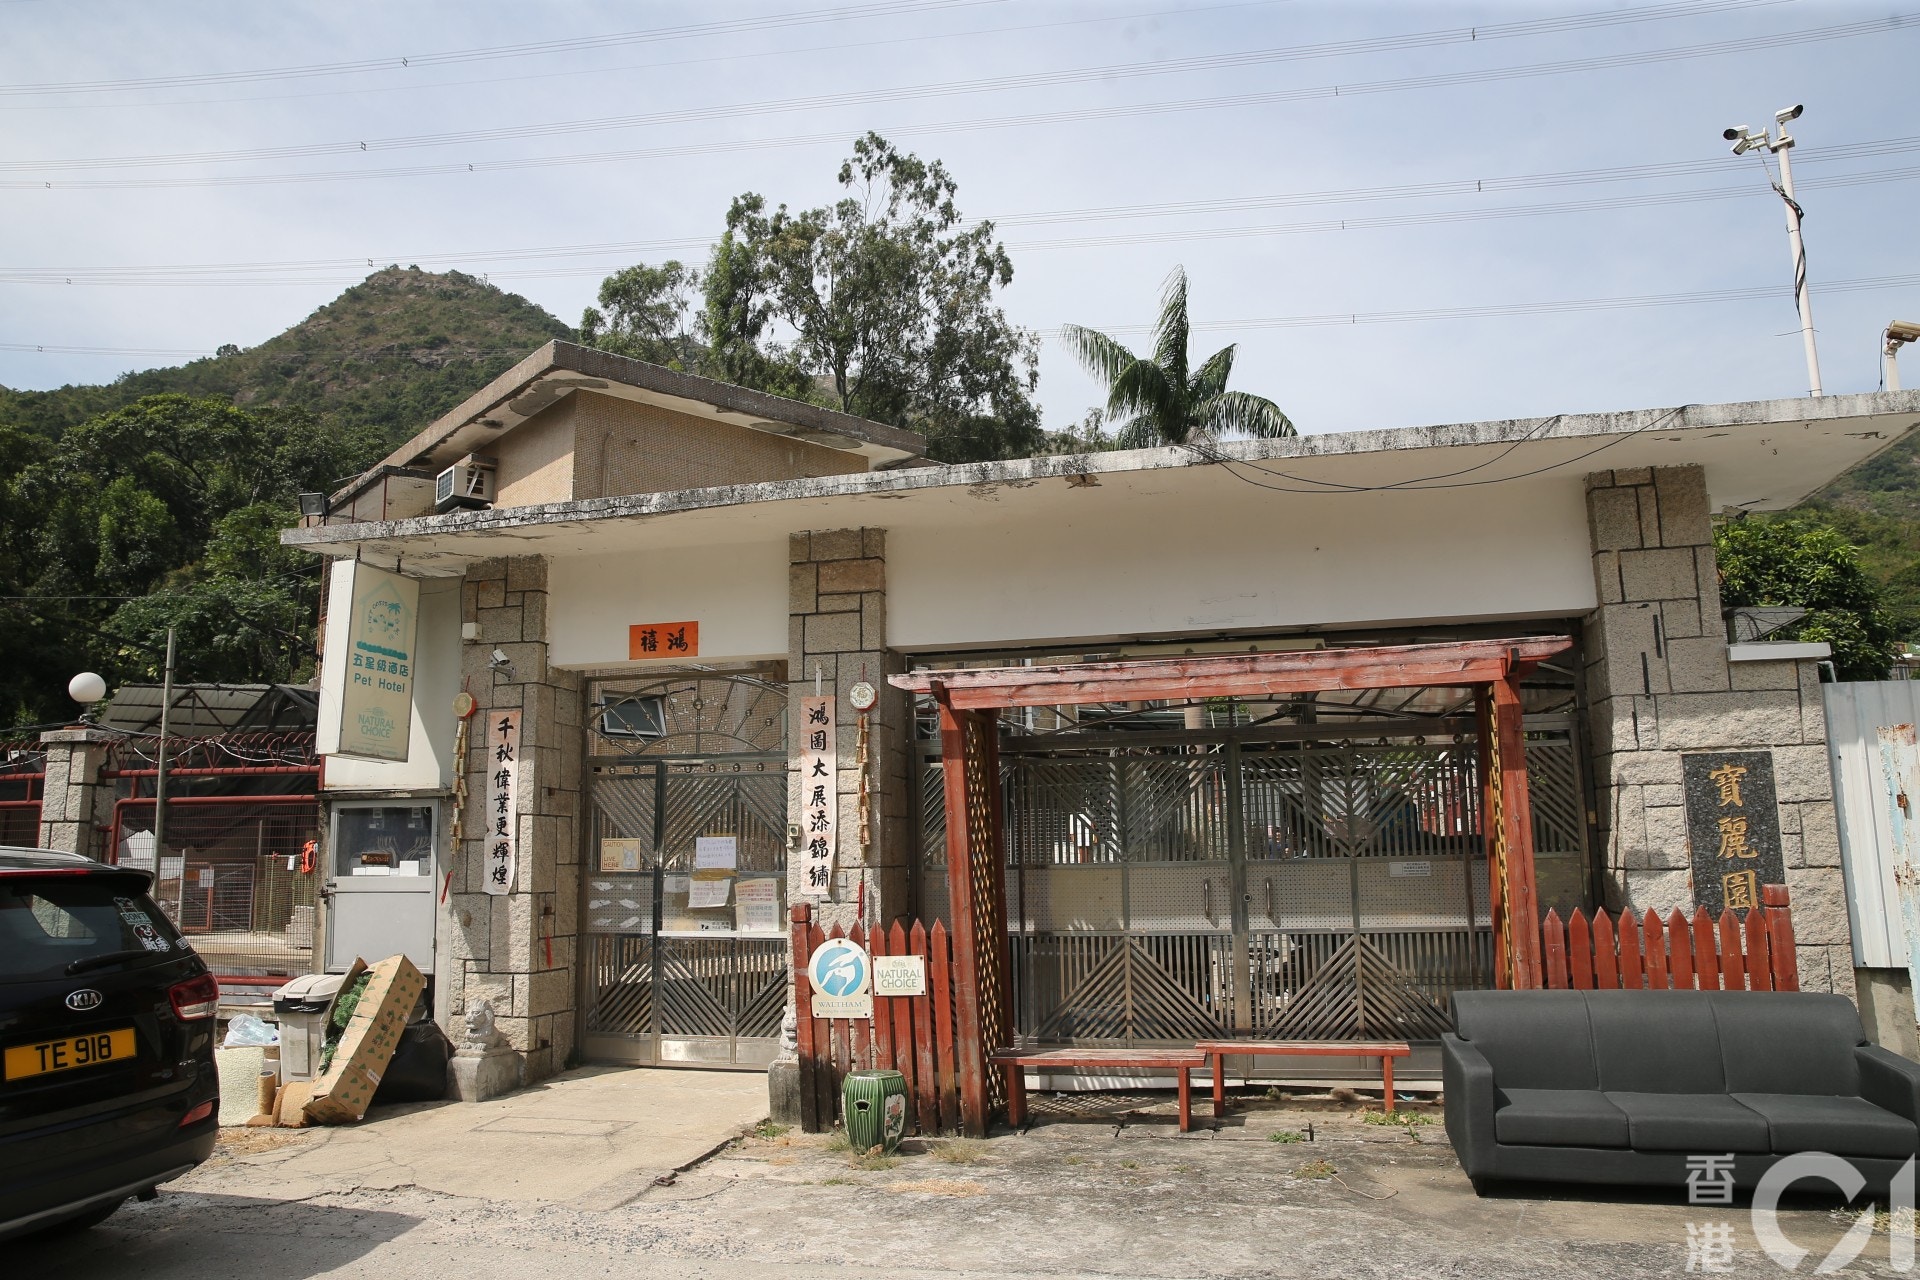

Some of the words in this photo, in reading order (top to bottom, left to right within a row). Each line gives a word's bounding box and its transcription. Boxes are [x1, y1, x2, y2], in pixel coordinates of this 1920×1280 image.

[353, 653, 409, 677] 五星級酒店
[354, 673, 372, 686] Pet
[378, 678, 405, 693] Hotel
[358, 714, 395, 729] NATURAL
[361, 725, 391, 738] CHOICE
[491, 716, 514, 885] 千秋偉業更輝煌
[808, 702, 830, 888] 鴻圖大展添錦繡
[1709, 762, 1759, 910] 寶麗園
[877, 969, 922, 979] NATURAL
[881, 979, 917, 988] CHOICE
[73, 992, 98, 1007] KIA
[35, 1041, 69, 1072] TE
[75, 1034, 112, 1064] 918
